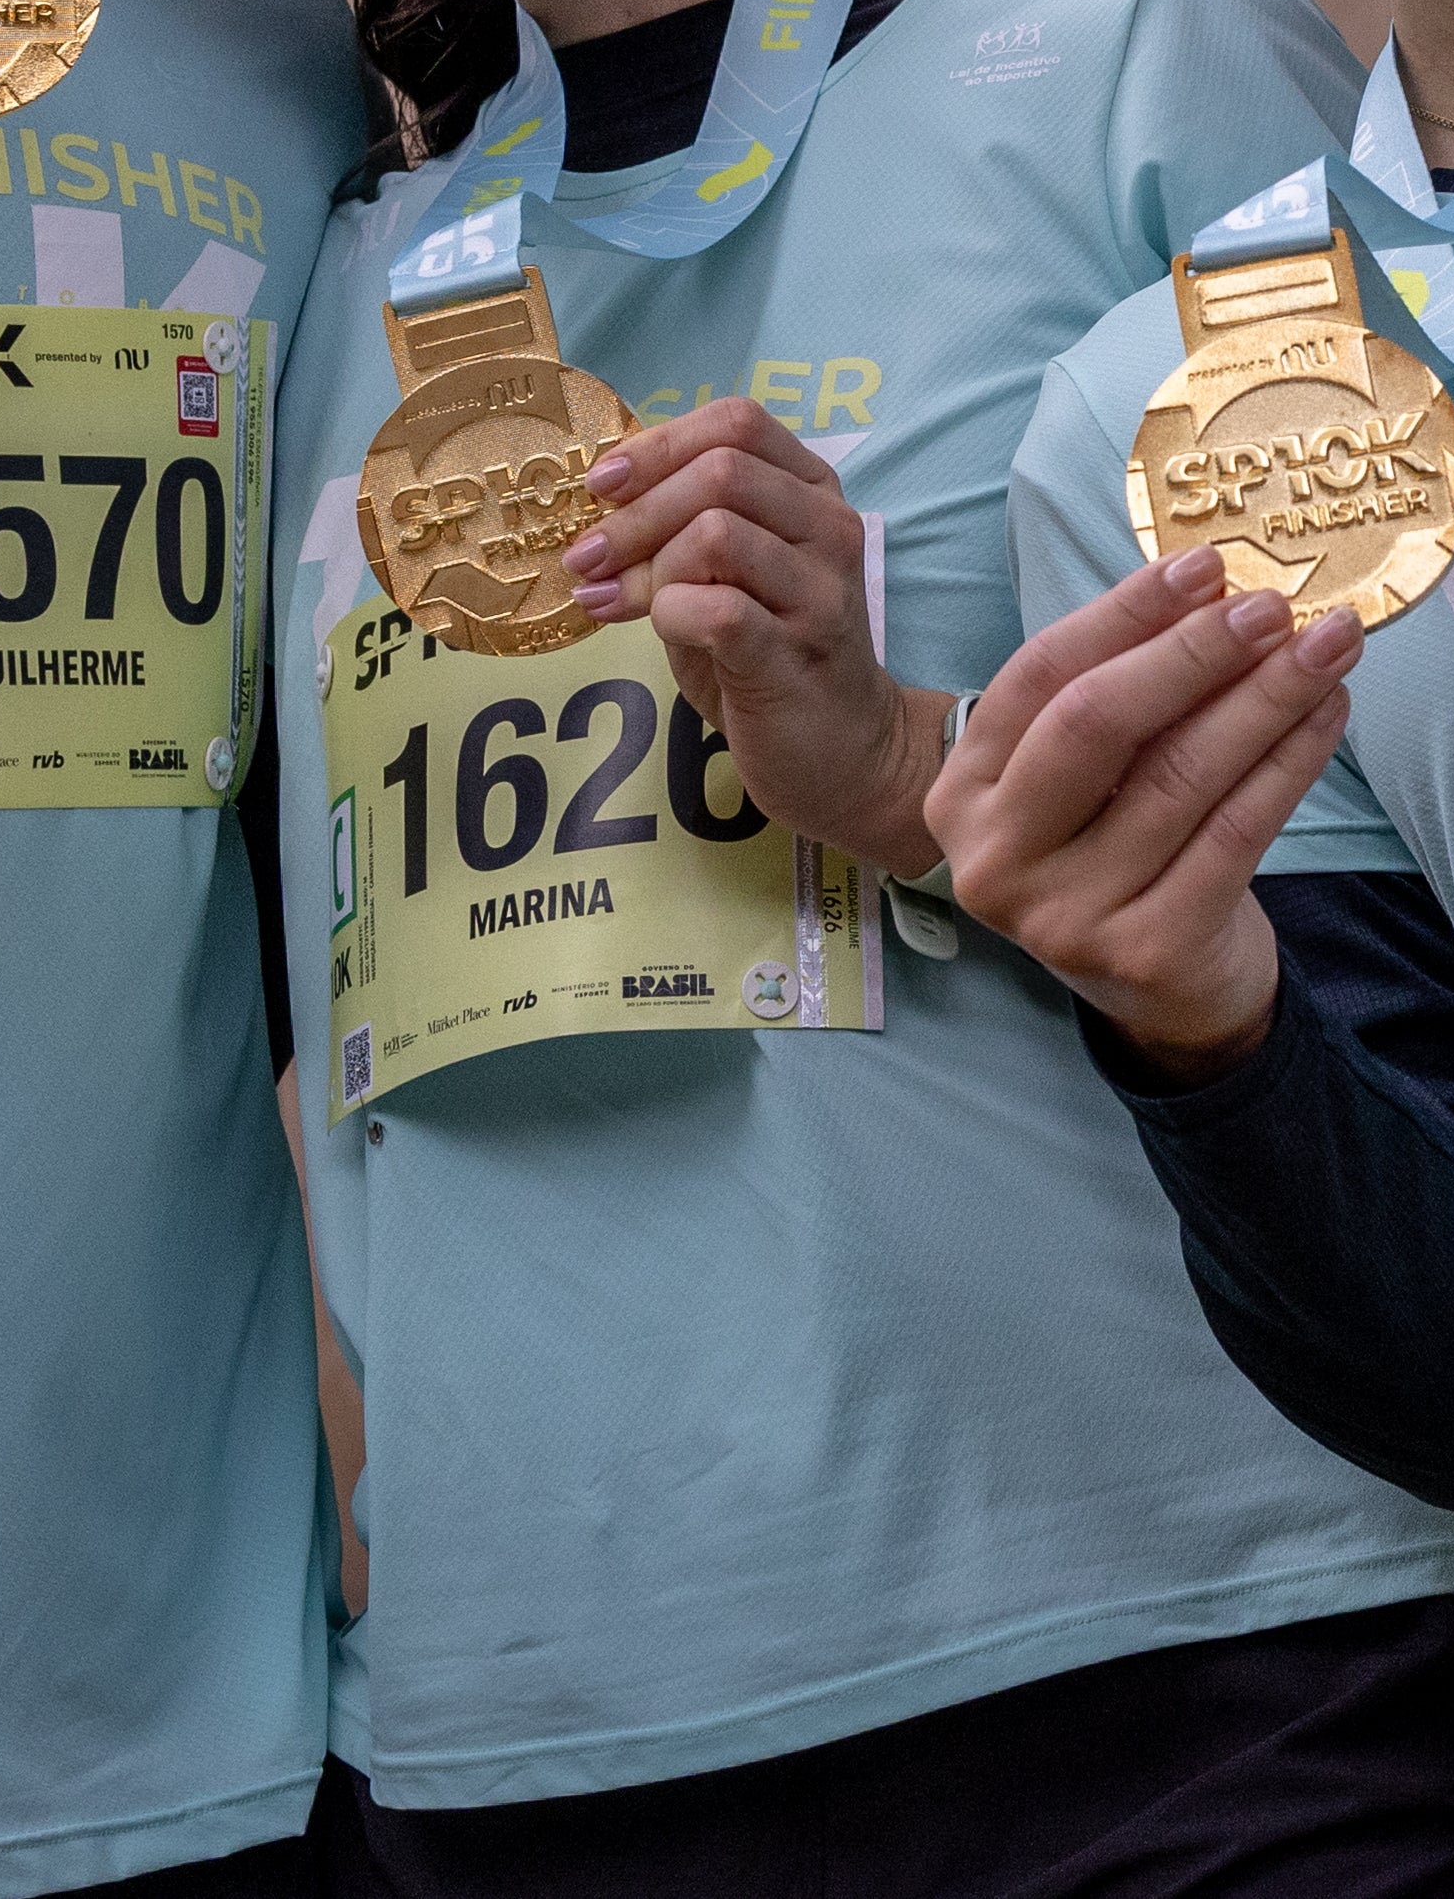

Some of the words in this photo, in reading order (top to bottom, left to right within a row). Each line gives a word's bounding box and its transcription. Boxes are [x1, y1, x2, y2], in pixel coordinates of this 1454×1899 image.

[161, 323, 195, 341] 1570
[34, 350, 86, 369] presented
[87, 350, 103, 367] by
[114, 346, 150, 372] nu
[1187, 359, 1251, 383] presented
[1279, 335, 1337, 374] nu
[1165, 409, 1441, 522] SP10K
[1261, 486, 1432, 542] FINISHER
[31, 750, 66, 770] rvb
[128, 748, 189, 772] BRASIL
[383, 678, 772, 900] 1626
[468, 877, 615, 940] MARINA
[822, 884, 844, 934] 1626
[622, 973, 715, 999] BRASIL
[460, 1004, 491, 1029] Place
[501, 991, 538, 1016] rvb
